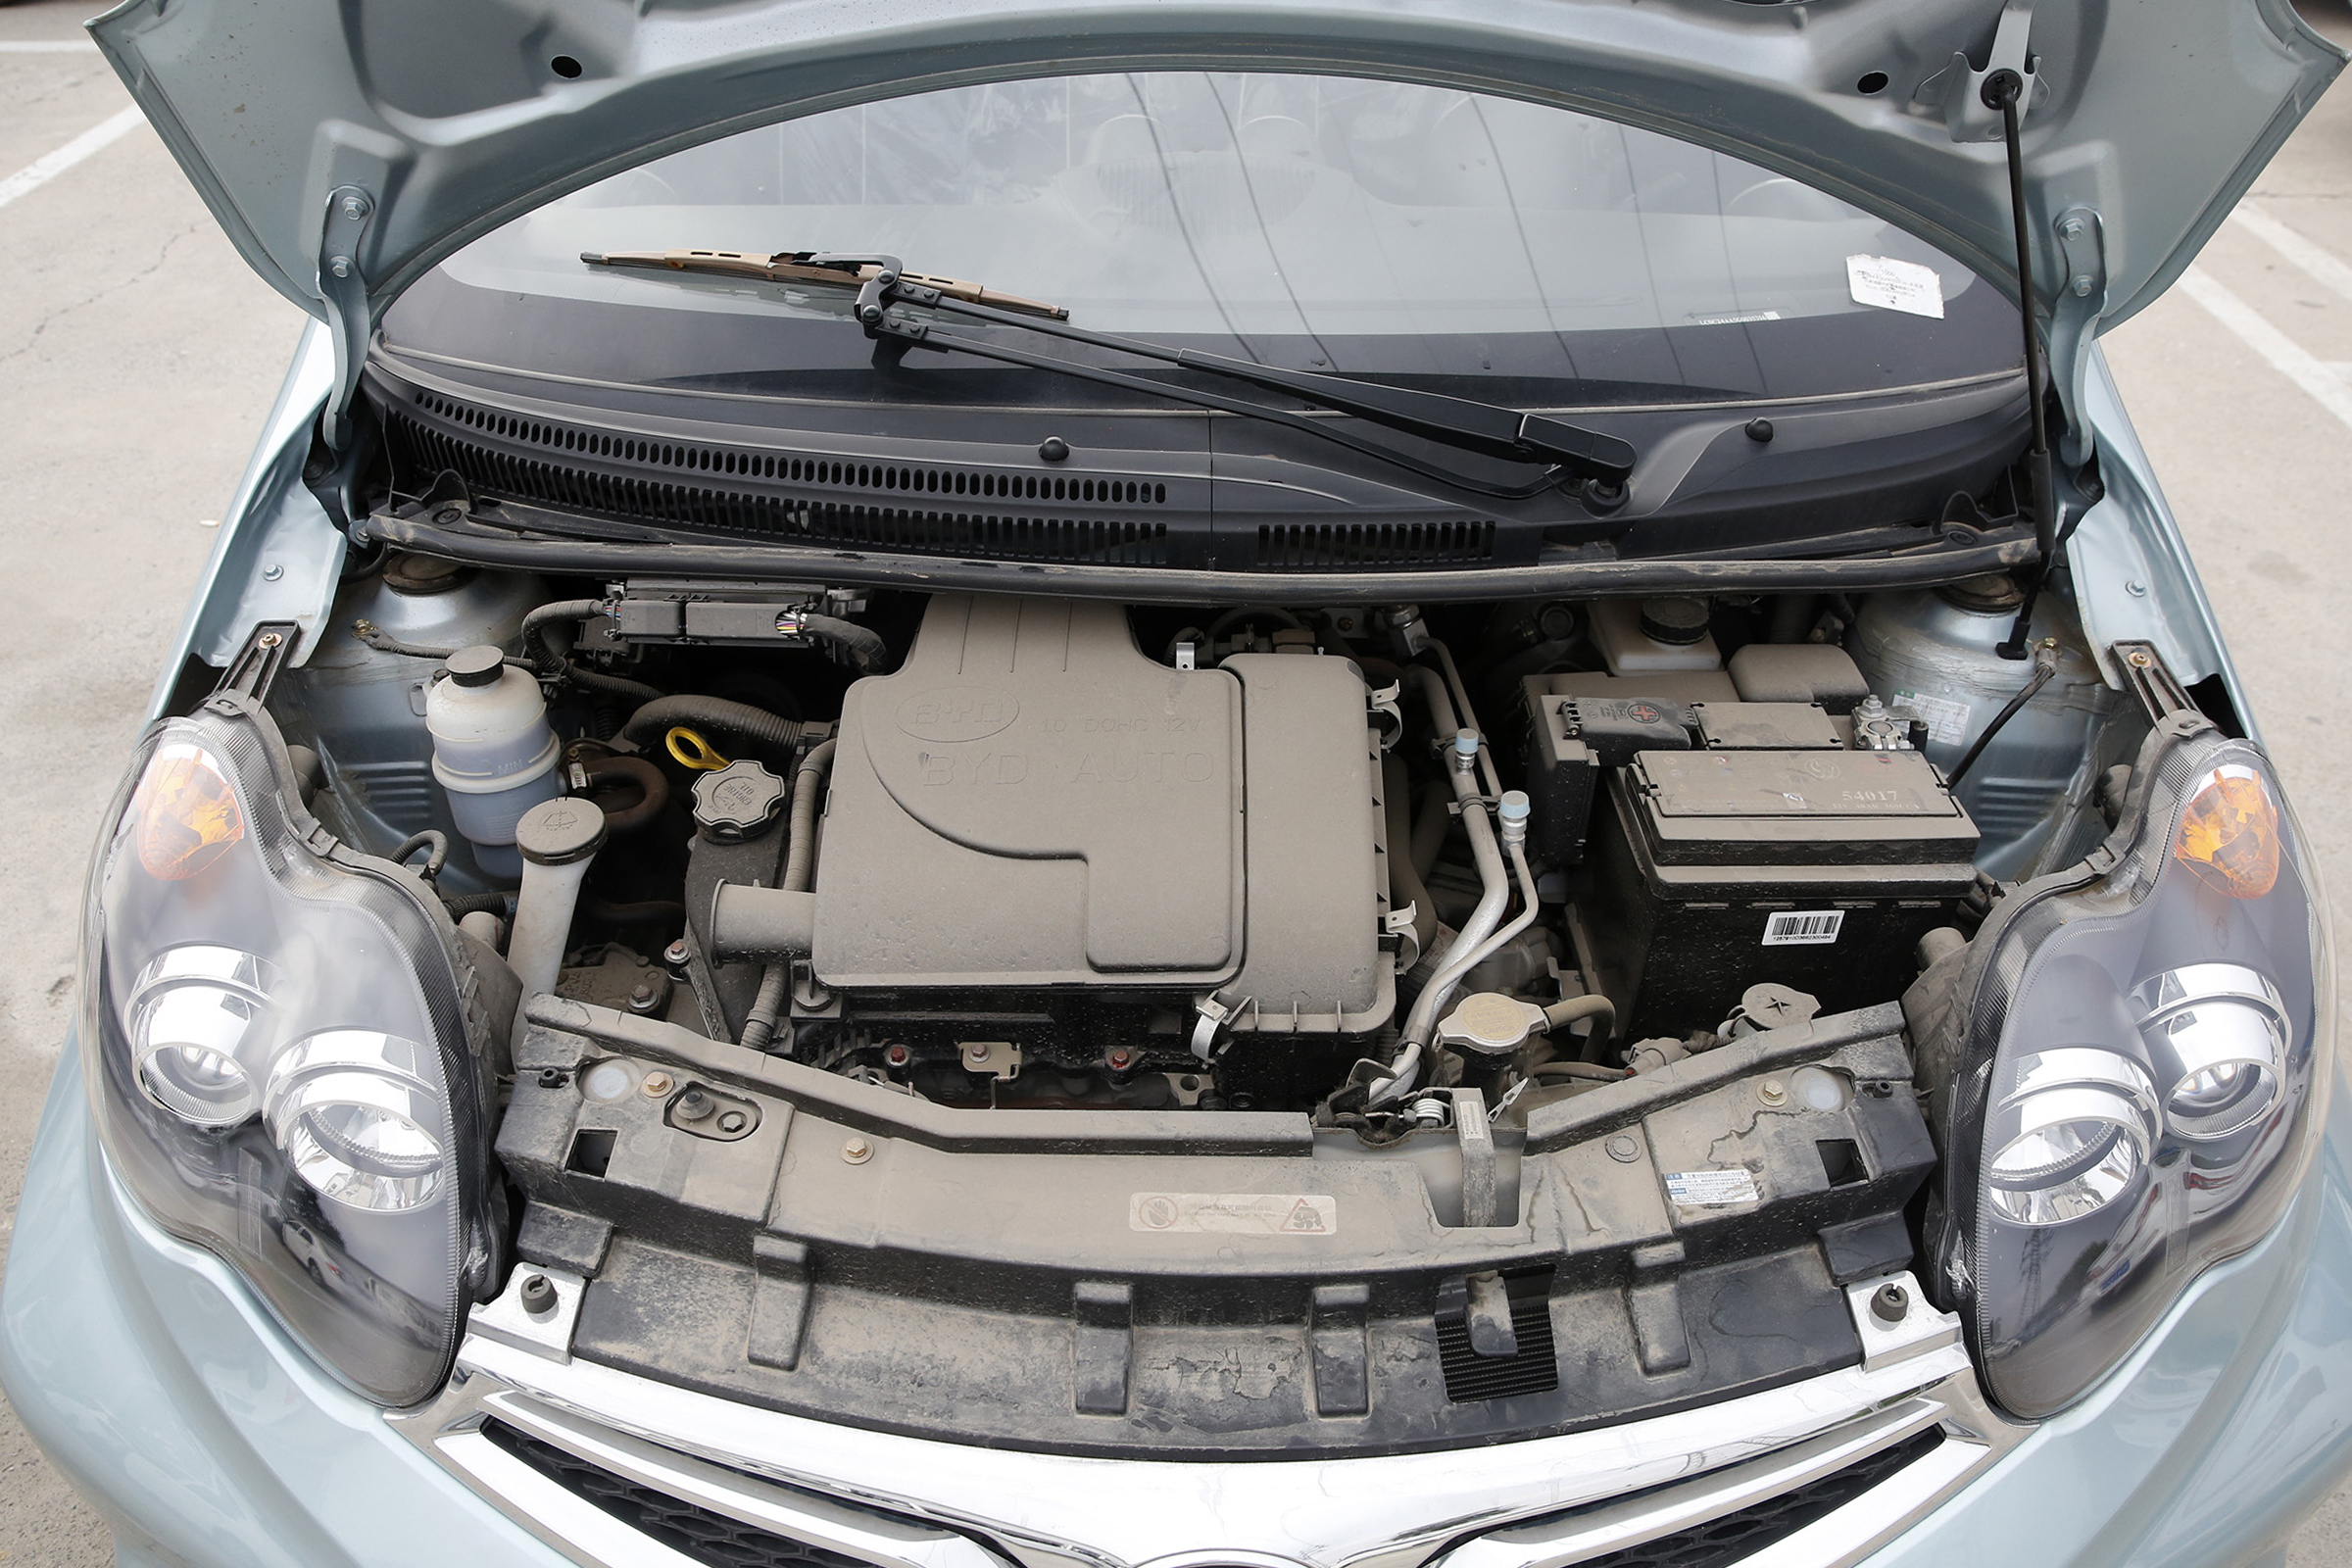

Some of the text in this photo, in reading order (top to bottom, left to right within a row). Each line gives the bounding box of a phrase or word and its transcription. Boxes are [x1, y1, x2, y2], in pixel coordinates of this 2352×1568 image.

[910, 699, 1004, 724] BYD
[1082, 717, 1150, 733] DOHC
[1162, 716, 1202, 733] 12V
[497, 759, 523, 776] MIN
[922, 751, 1214, 787] BYD AUTO
[723, 783, 753, 806] ENGINE
[739, 781, 756, 796] OIL
[1841, 790, 1897, 802] 54017
